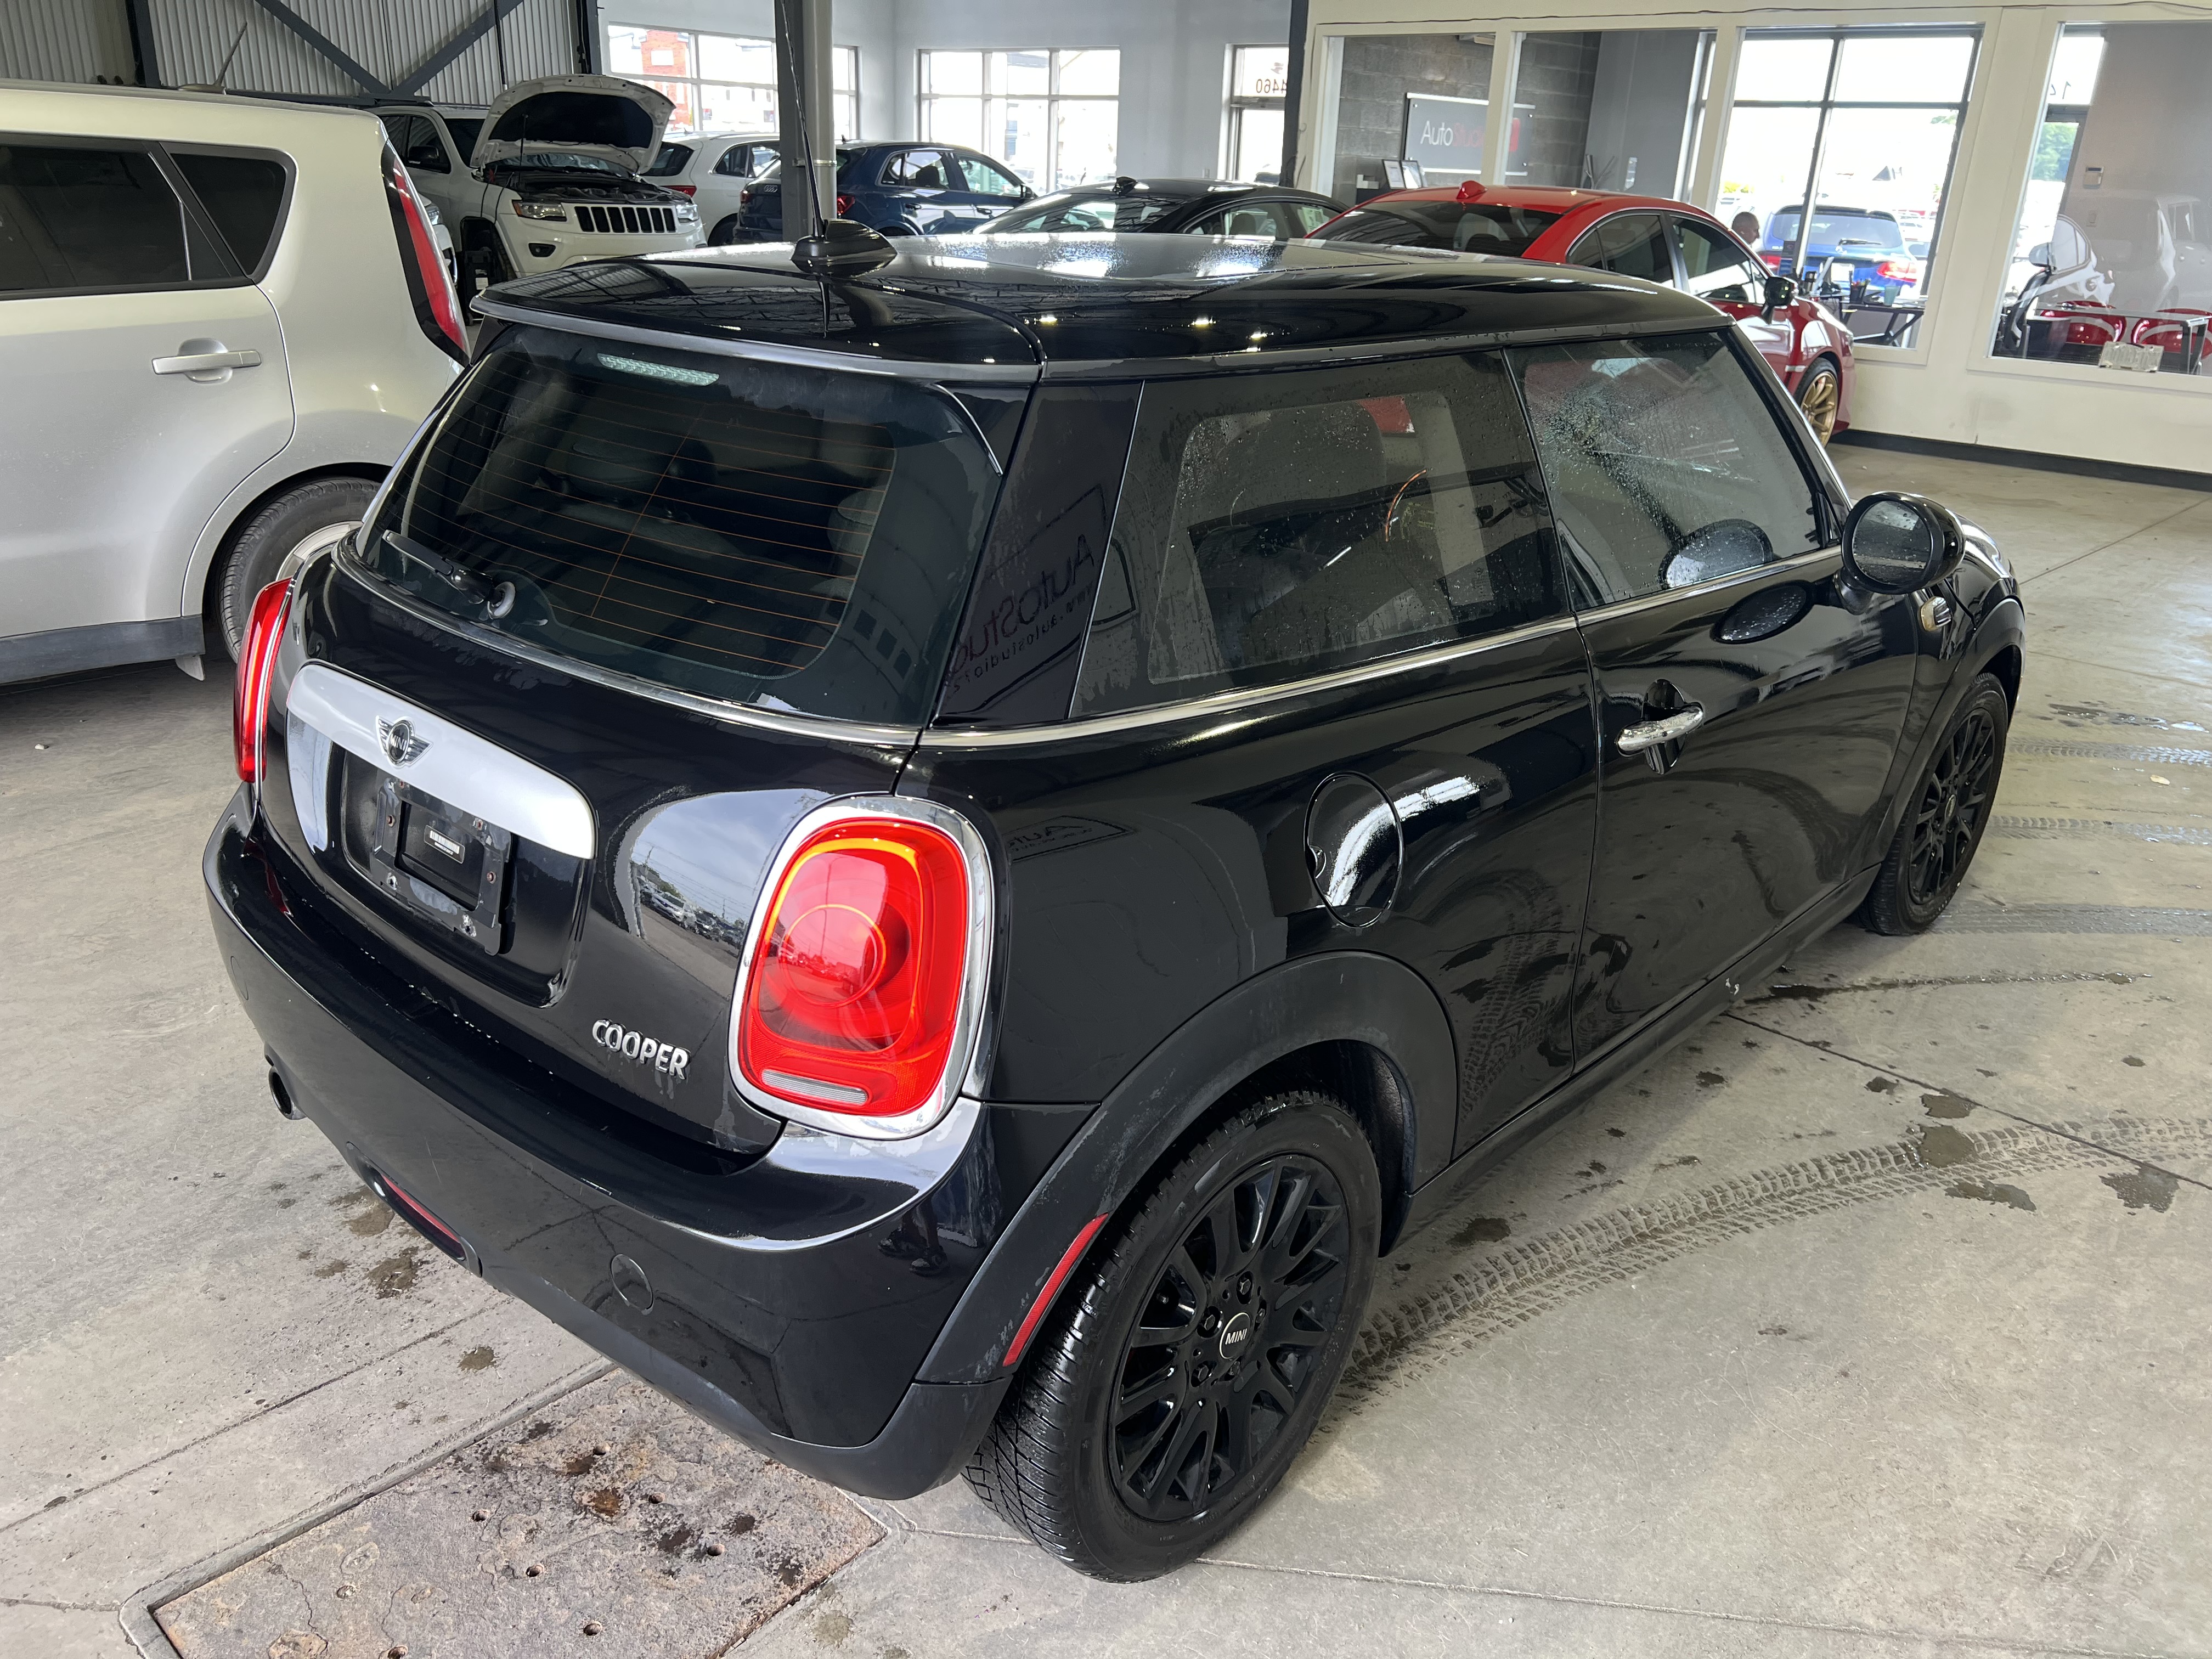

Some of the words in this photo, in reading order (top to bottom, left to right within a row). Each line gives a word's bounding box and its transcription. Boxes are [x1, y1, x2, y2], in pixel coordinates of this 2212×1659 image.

[391, 734, 408, 751] MINI
[592, 1018, 692, 1080] COOPER
[1224, 1328, 1248, 1345] MINI
